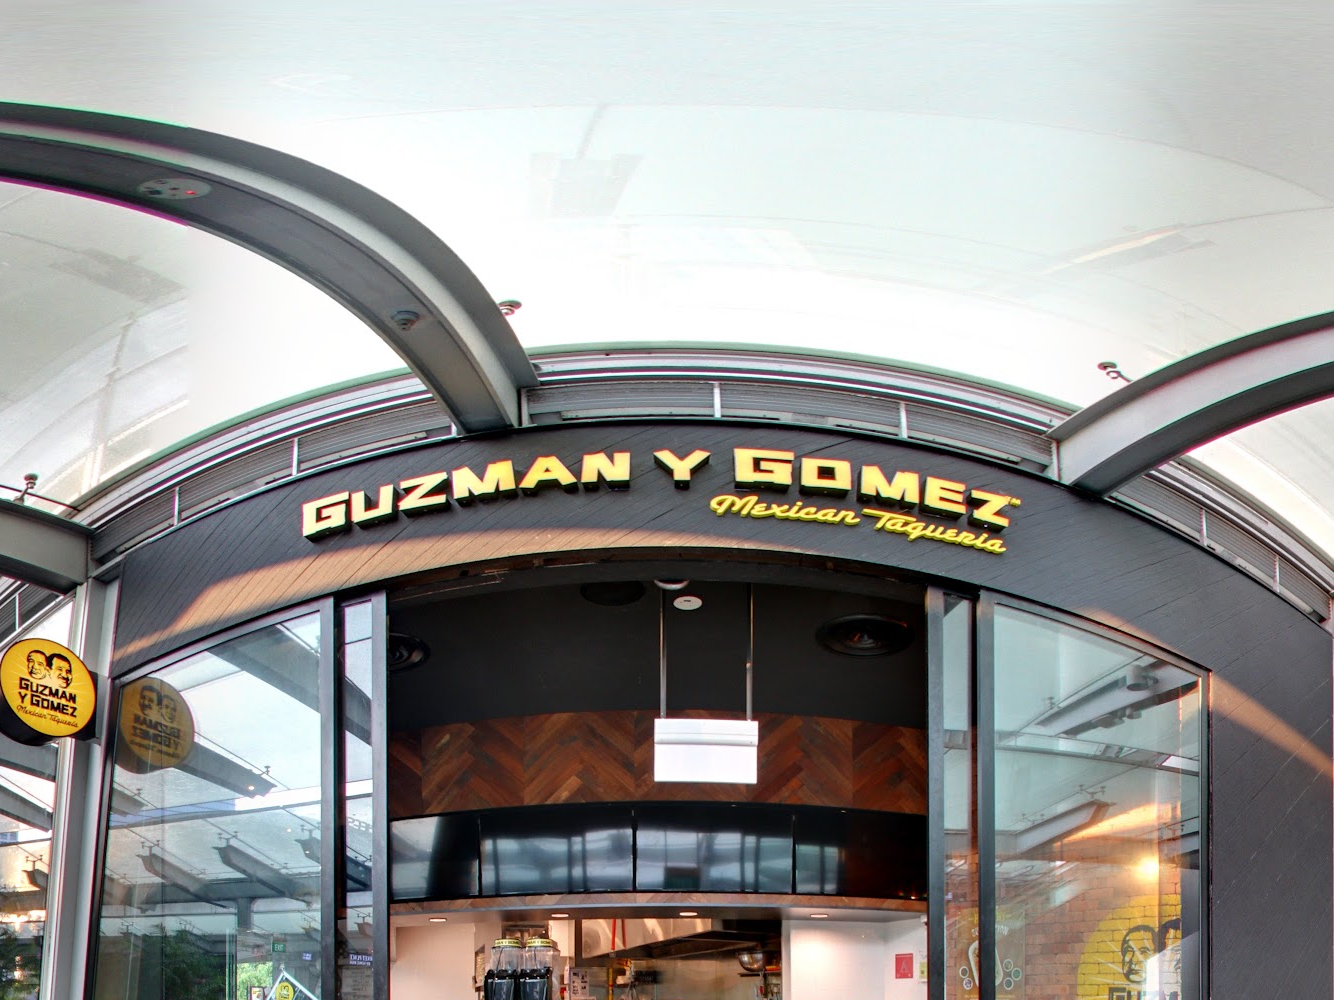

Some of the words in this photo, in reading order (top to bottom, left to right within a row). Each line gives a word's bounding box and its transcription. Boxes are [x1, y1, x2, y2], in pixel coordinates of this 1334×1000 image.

[301, 450, 631, 539] GUZMAN
[653, 448, 710, 489] Y
[733, 447, 1012, 530] GOMEZ
[709, 493, 861, 527] Mexican
[862, 508, 1007, 555] Taqueria
[19, 677, 76, 704] GUZMAN
[16, 705, 47, 719] Mexican
[48, 714, 78, 728] Taqueria
[18, 692, 27, 704] Y
[30, 694, 77, 718] GOMEZ
[274, 943, 284, 951] EXIT
